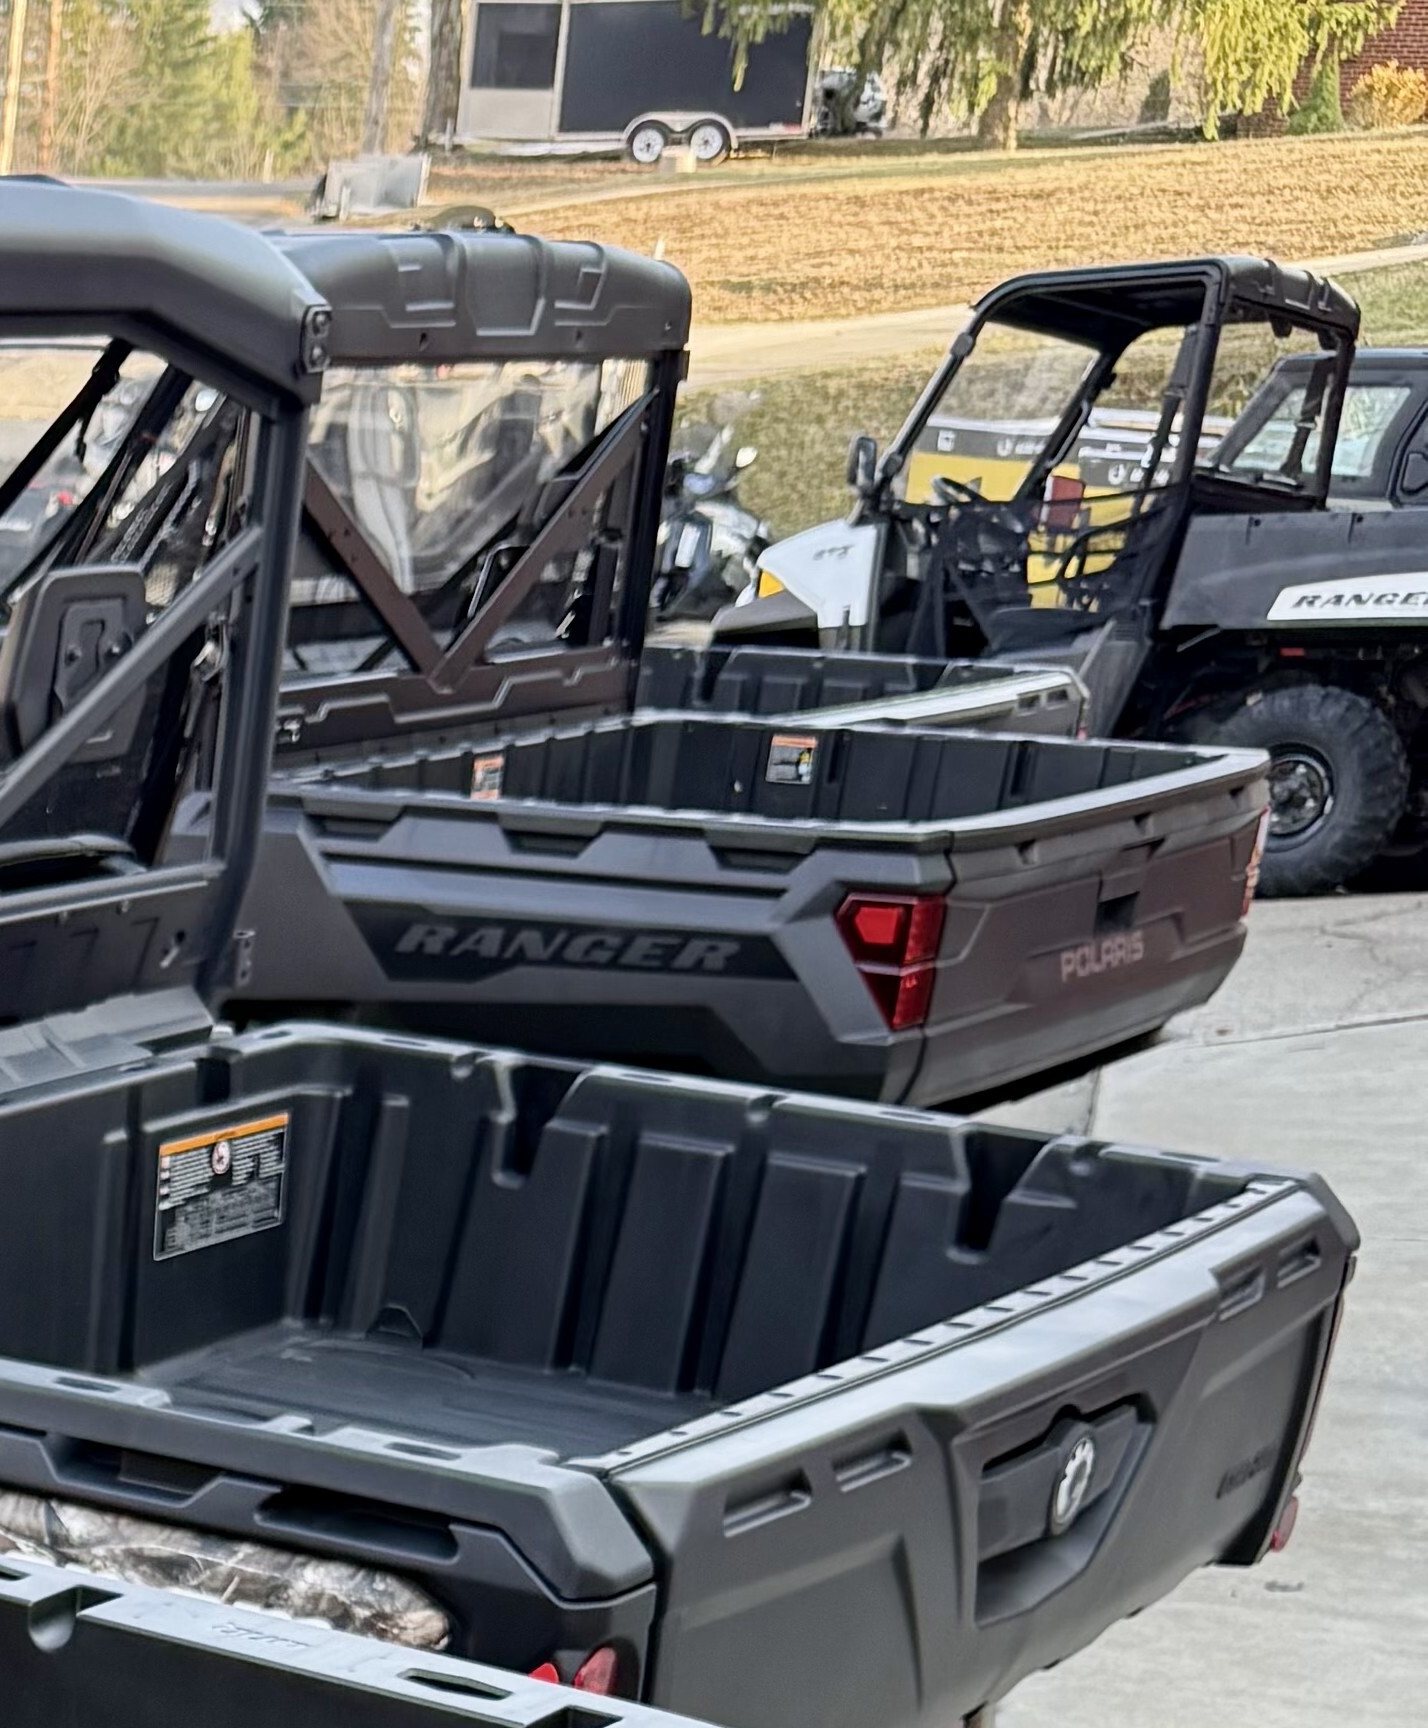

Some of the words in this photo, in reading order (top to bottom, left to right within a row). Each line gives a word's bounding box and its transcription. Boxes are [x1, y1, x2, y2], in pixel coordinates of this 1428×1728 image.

[1292, 590, 1428, 608] RANGE
[394, 924, 741, 972] RANGER
[1059, 929, 1145, 984] POLARIS
